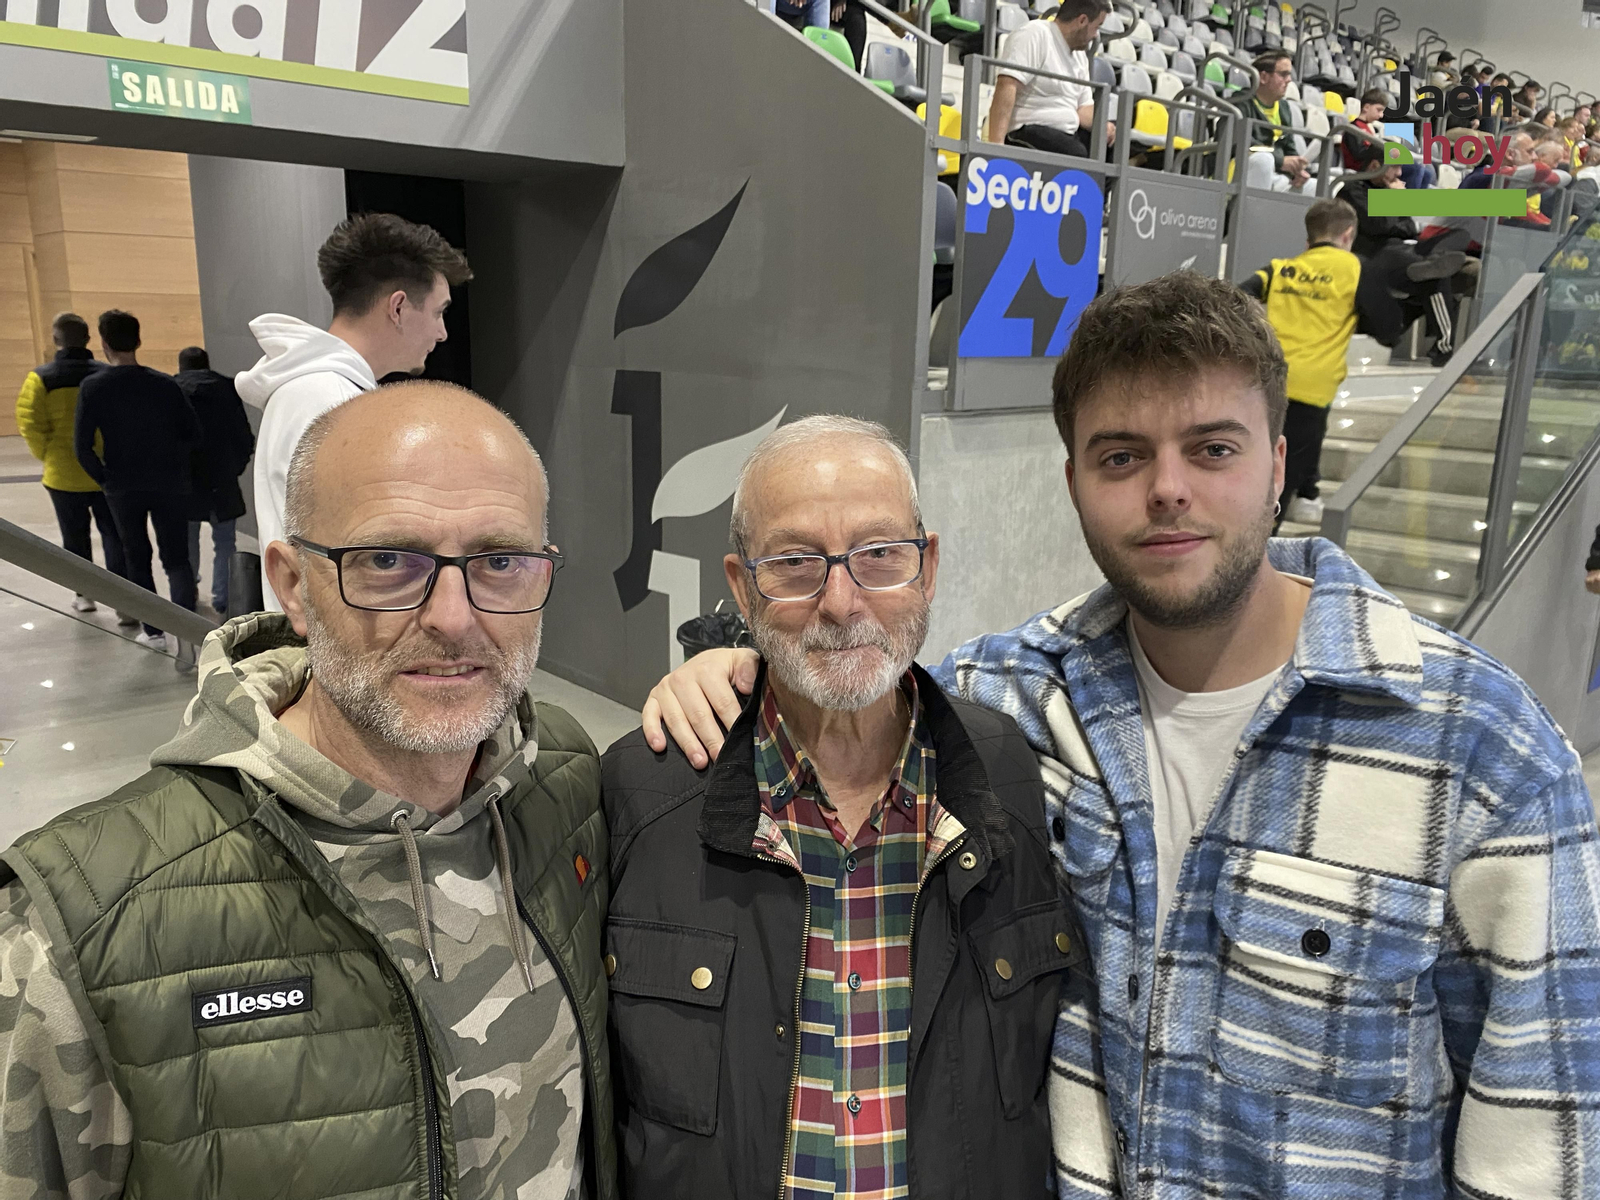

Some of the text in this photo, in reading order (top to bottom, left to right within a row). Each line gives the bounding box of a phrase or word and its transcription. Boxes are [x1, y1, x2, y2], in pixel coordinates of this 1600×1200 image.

[121, 71, 240, 114] SALIDA
[966, 156, 1079, 215] Sector
[1160, 208, 1218, 231] olivo arena
[958, 158, 1104, 357] 29
[200, 989, 305, 1020] ellesse
